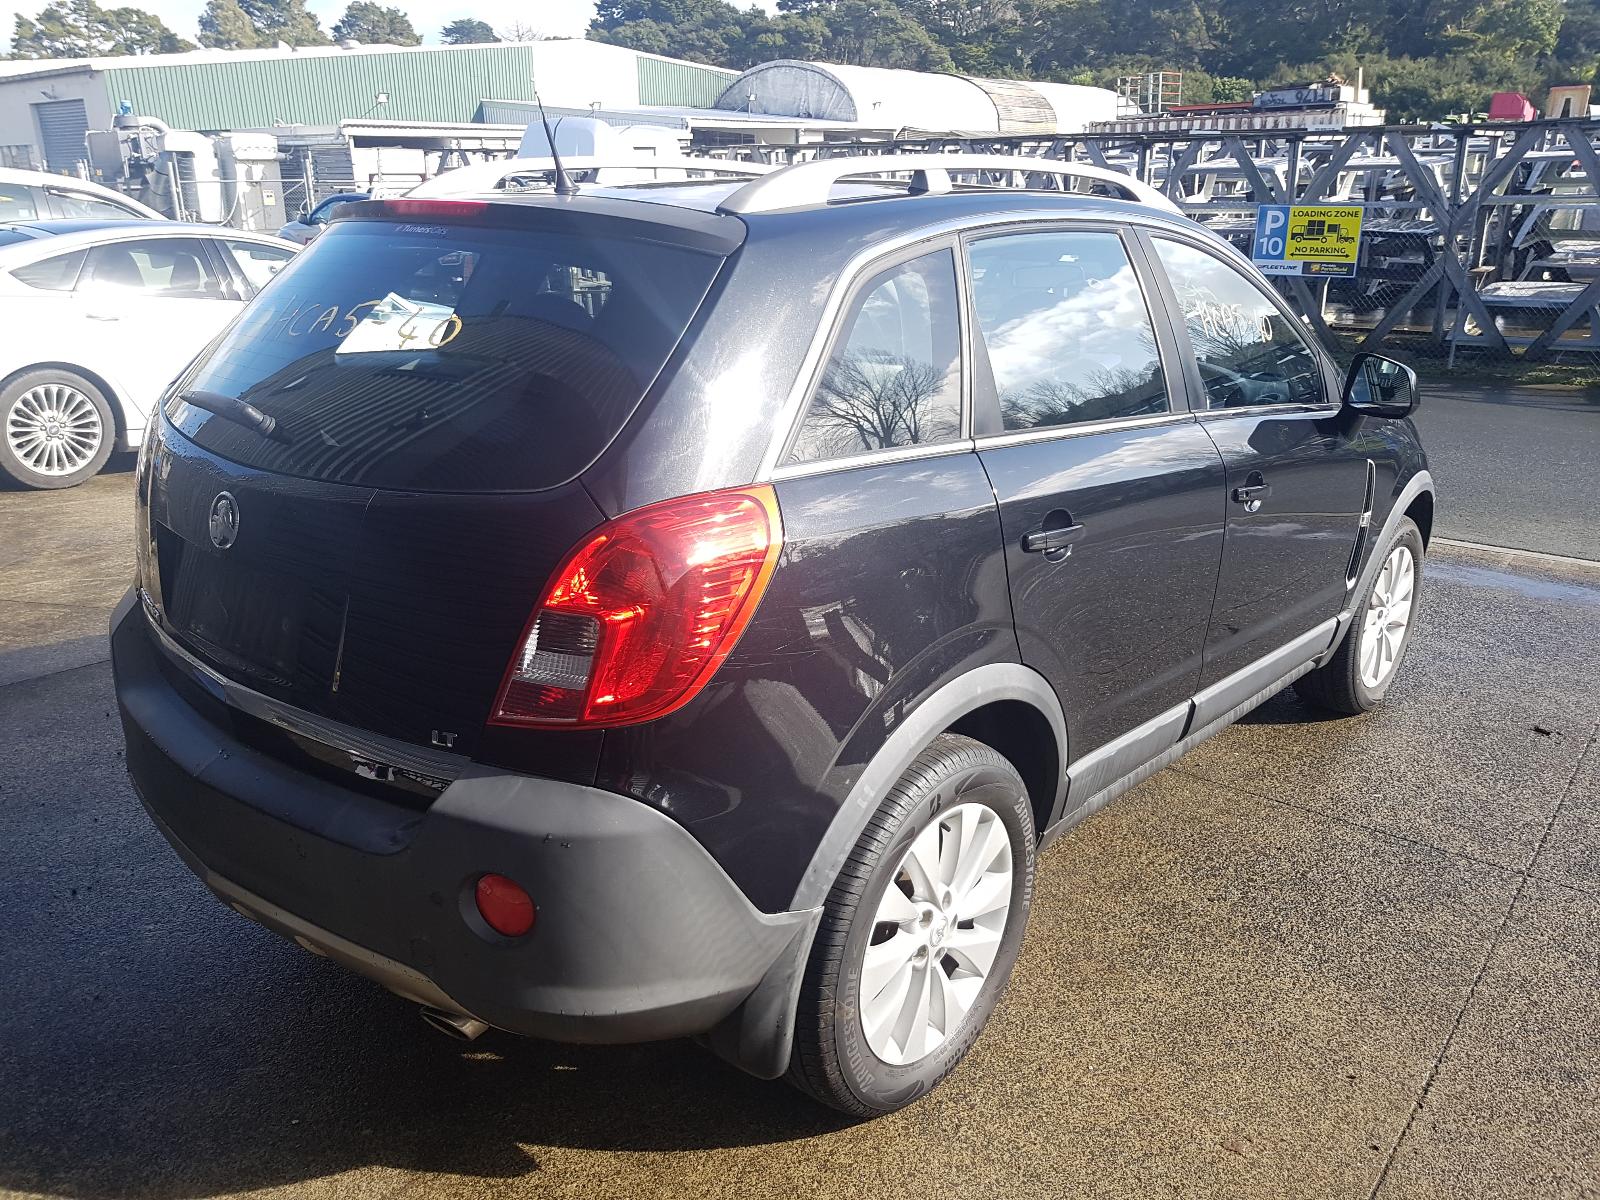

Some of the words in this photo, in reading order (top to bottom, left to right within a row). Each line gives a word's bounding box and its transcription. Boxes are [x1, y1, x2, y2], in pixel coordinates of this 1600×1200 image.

[1265, 210, 1285, 235] P
[1293, 210, 1333, 218] LOADING
[1334, 210, 1360, 218] ZONE
[1260, 237, 1283, 256] 10
[1309, 246, 1346, 255] PARKING
[431, 729, 458, 748] LT
[1014, 796, 1035, 911] BRIDGESTONE
